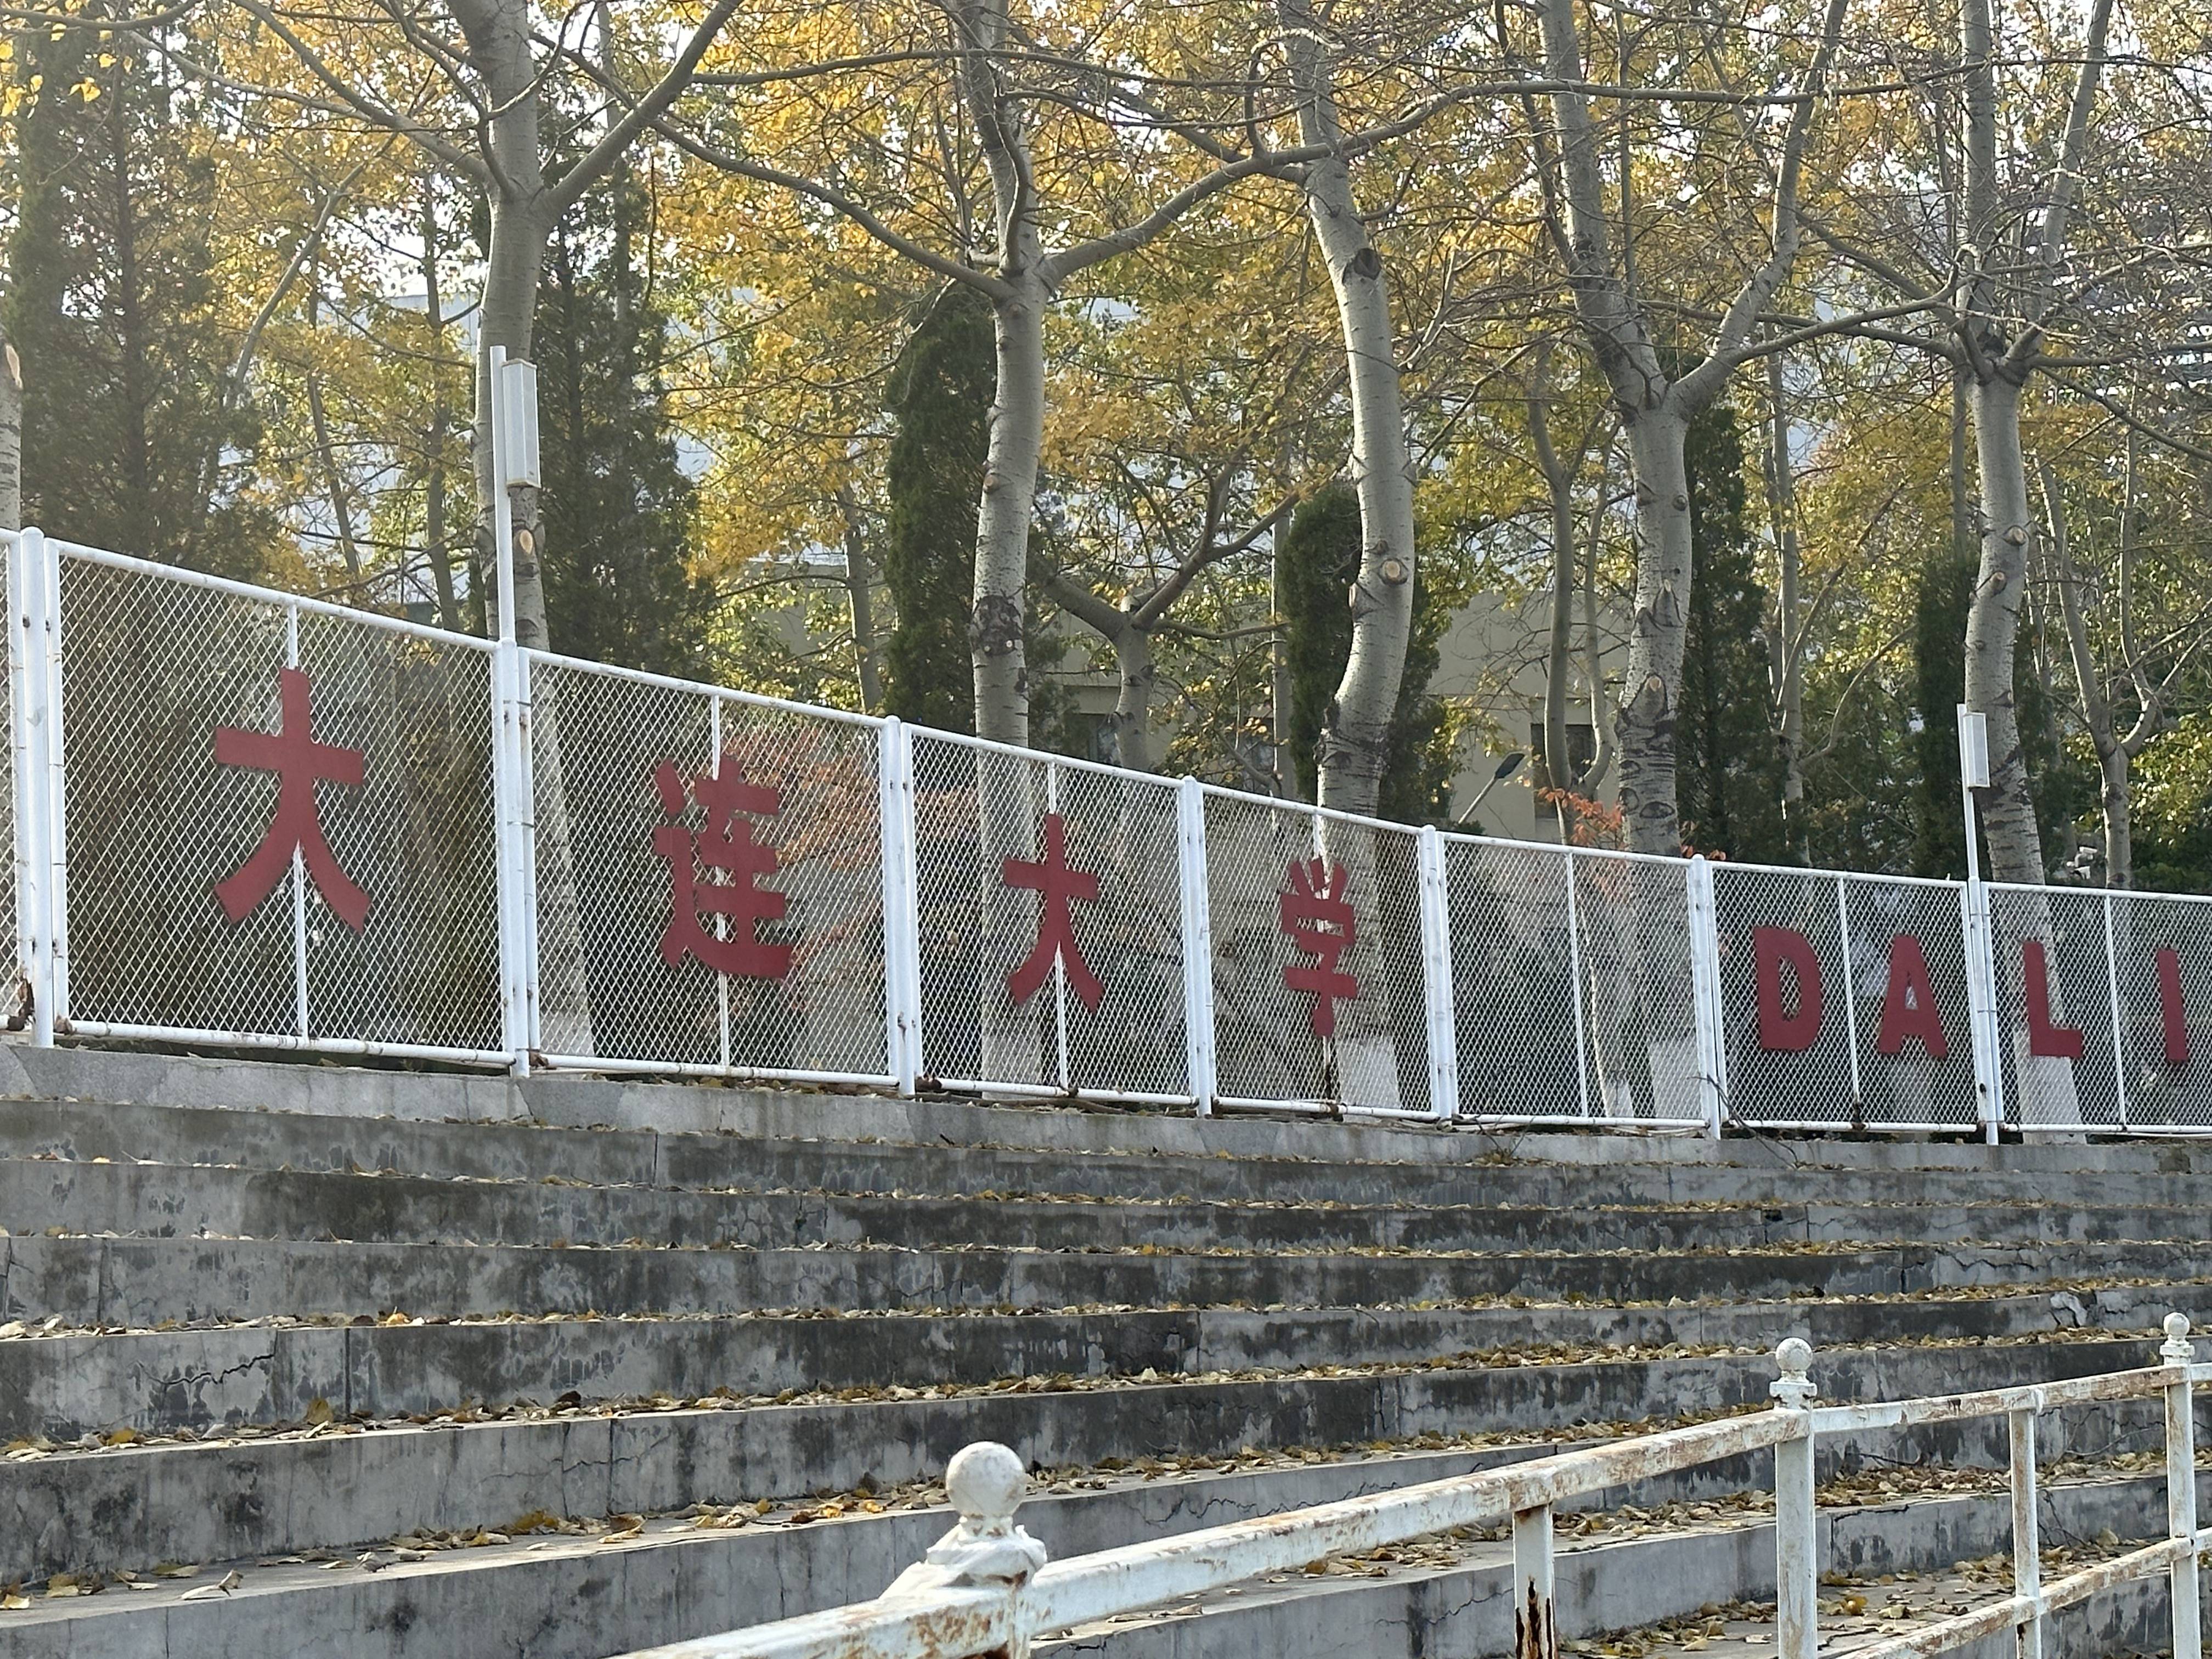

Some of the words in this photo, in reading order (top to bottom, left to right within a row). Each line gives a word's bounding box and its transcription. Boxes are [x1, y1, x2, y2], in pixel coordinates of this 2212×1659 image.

[215, 667, 1357, 1037] 大连大学
[1755, 926, 2188, 1062] DALI
